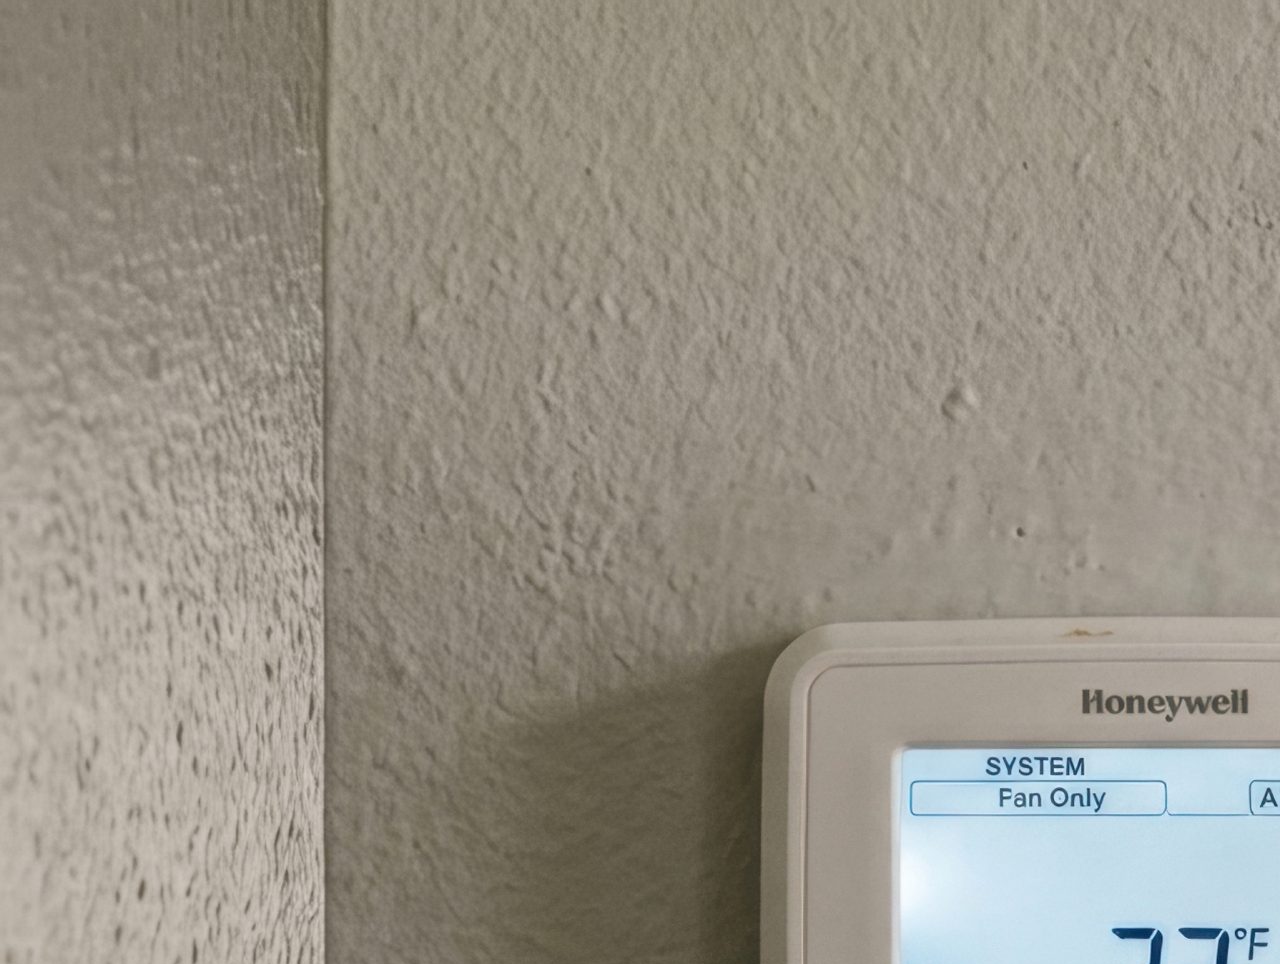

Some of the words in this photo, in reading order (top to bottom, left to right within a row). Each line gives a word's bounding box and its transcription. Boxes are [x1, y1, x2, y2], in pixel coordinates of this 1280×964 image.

[1082, 689, 1248, 722] Honeywell
[985, 757, 1085, 776] SYSTEM
[999, 787, 1042, 807] Fan
[1050, 787, 1106, 813] Only
